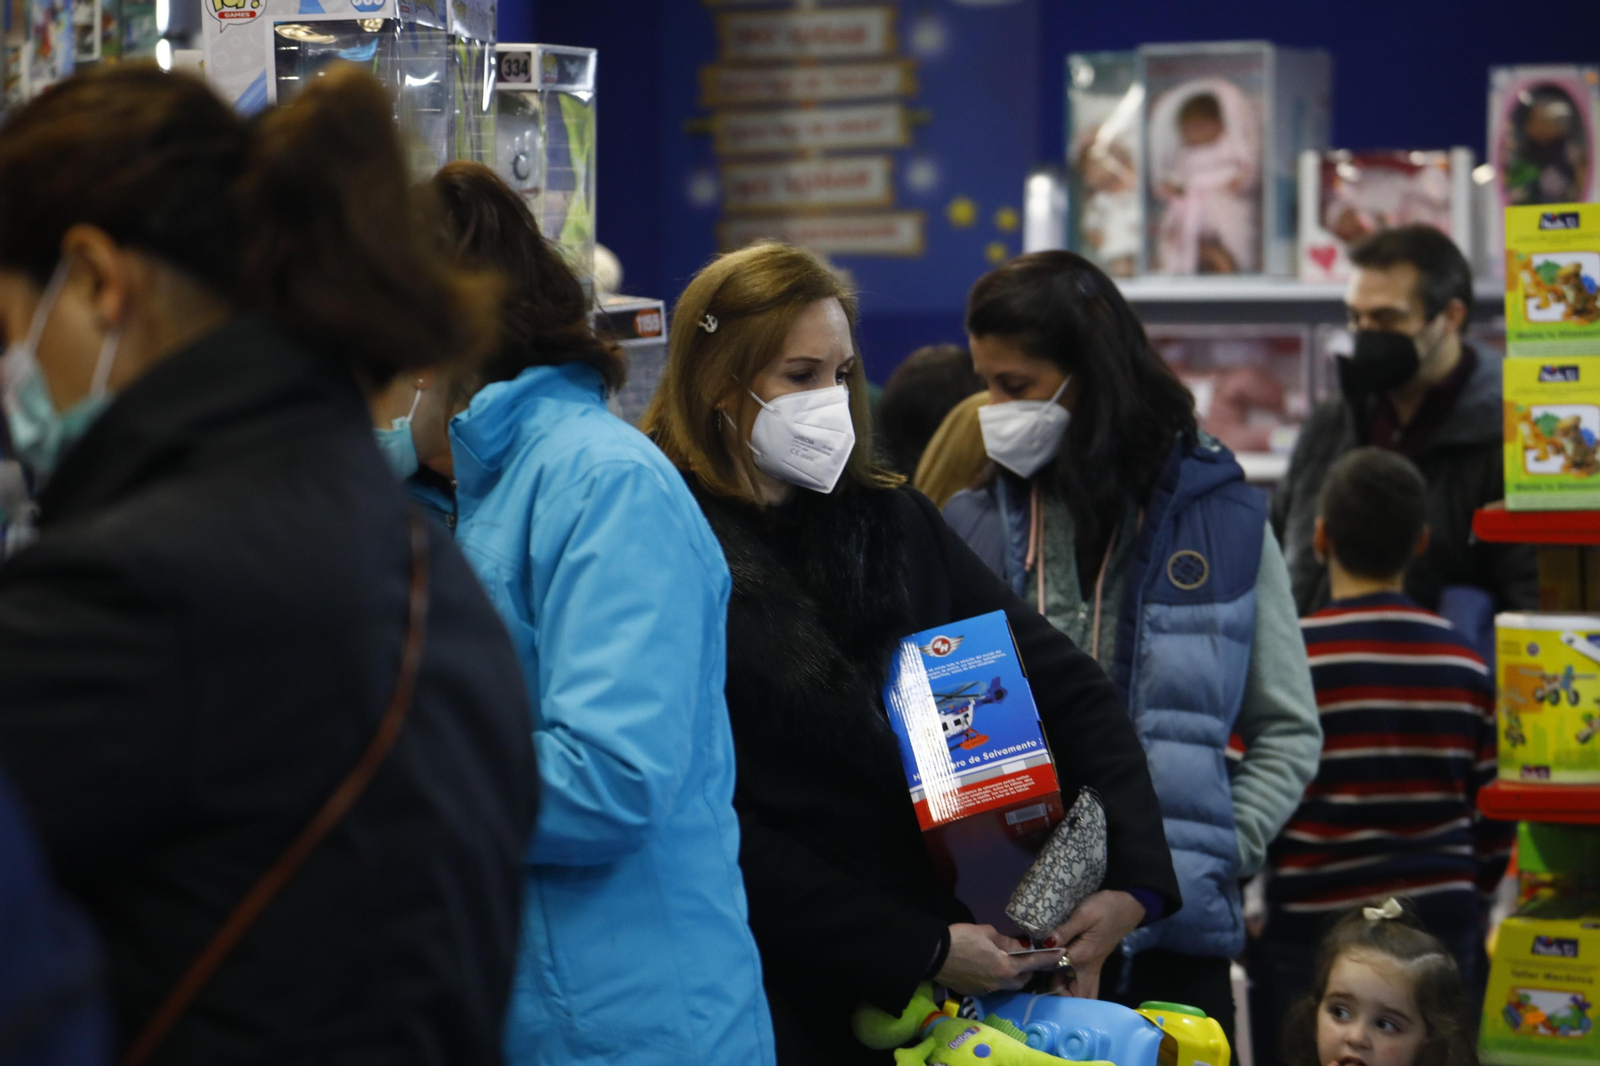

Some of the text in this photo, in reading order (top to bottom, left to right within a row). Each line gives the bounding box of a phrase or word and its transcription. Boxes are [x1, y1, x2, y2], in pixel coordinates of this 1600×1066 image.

[504, 58, 529, 77] 334
[968, 755, 981, 765] de
[982, 740, 1037, 761] Salvamento
